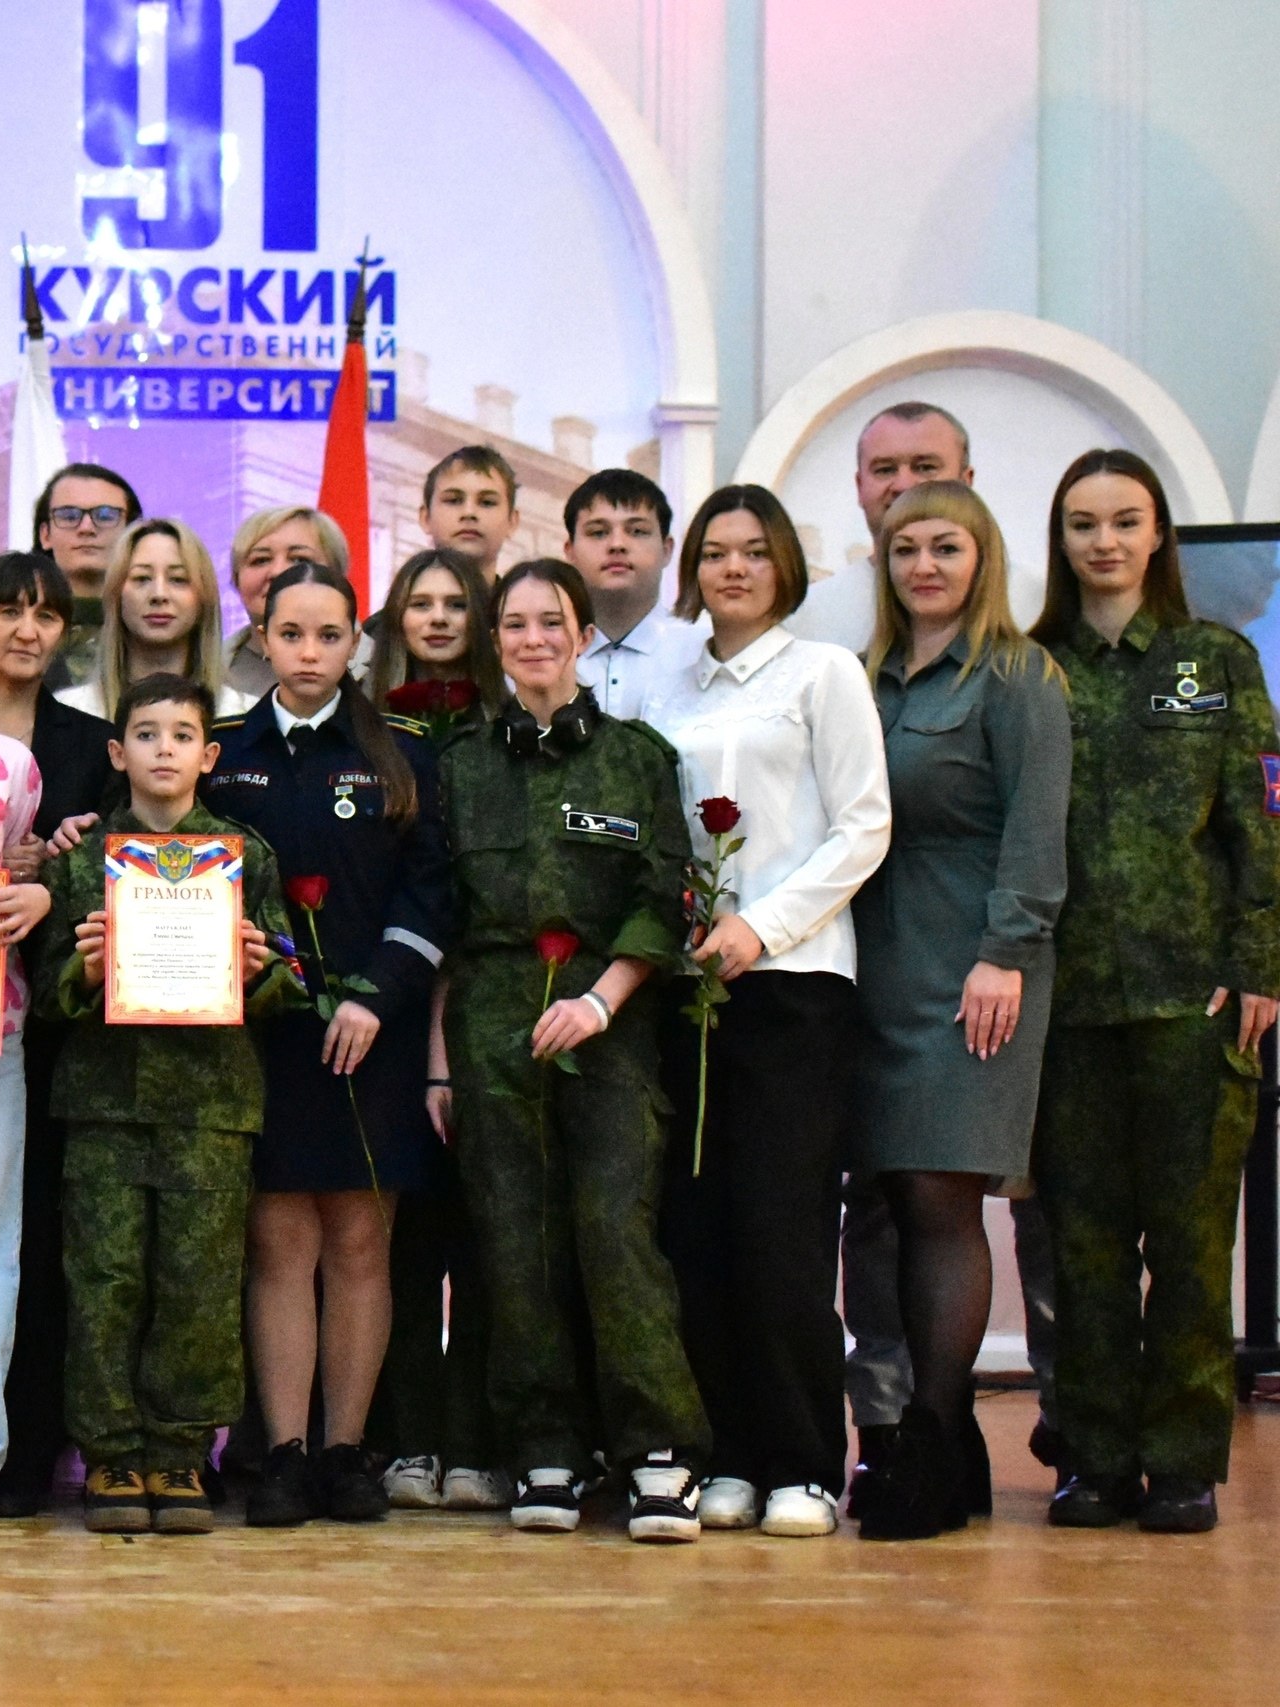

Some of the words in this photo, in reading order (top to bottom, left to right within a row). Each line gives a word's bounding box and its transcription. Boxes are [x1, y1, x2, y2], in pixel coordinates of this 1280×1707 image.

[83, 0, 317, 251] 91
[21, 256, 396, 325] КУРСКИЙ
[20, 331, 396, 359] ГОСУДАРСТВЕННЙ
[60, 377, 389, 414] НИВЕРСИТТ
[133, 887, 213, 900] ГРАМОТА
